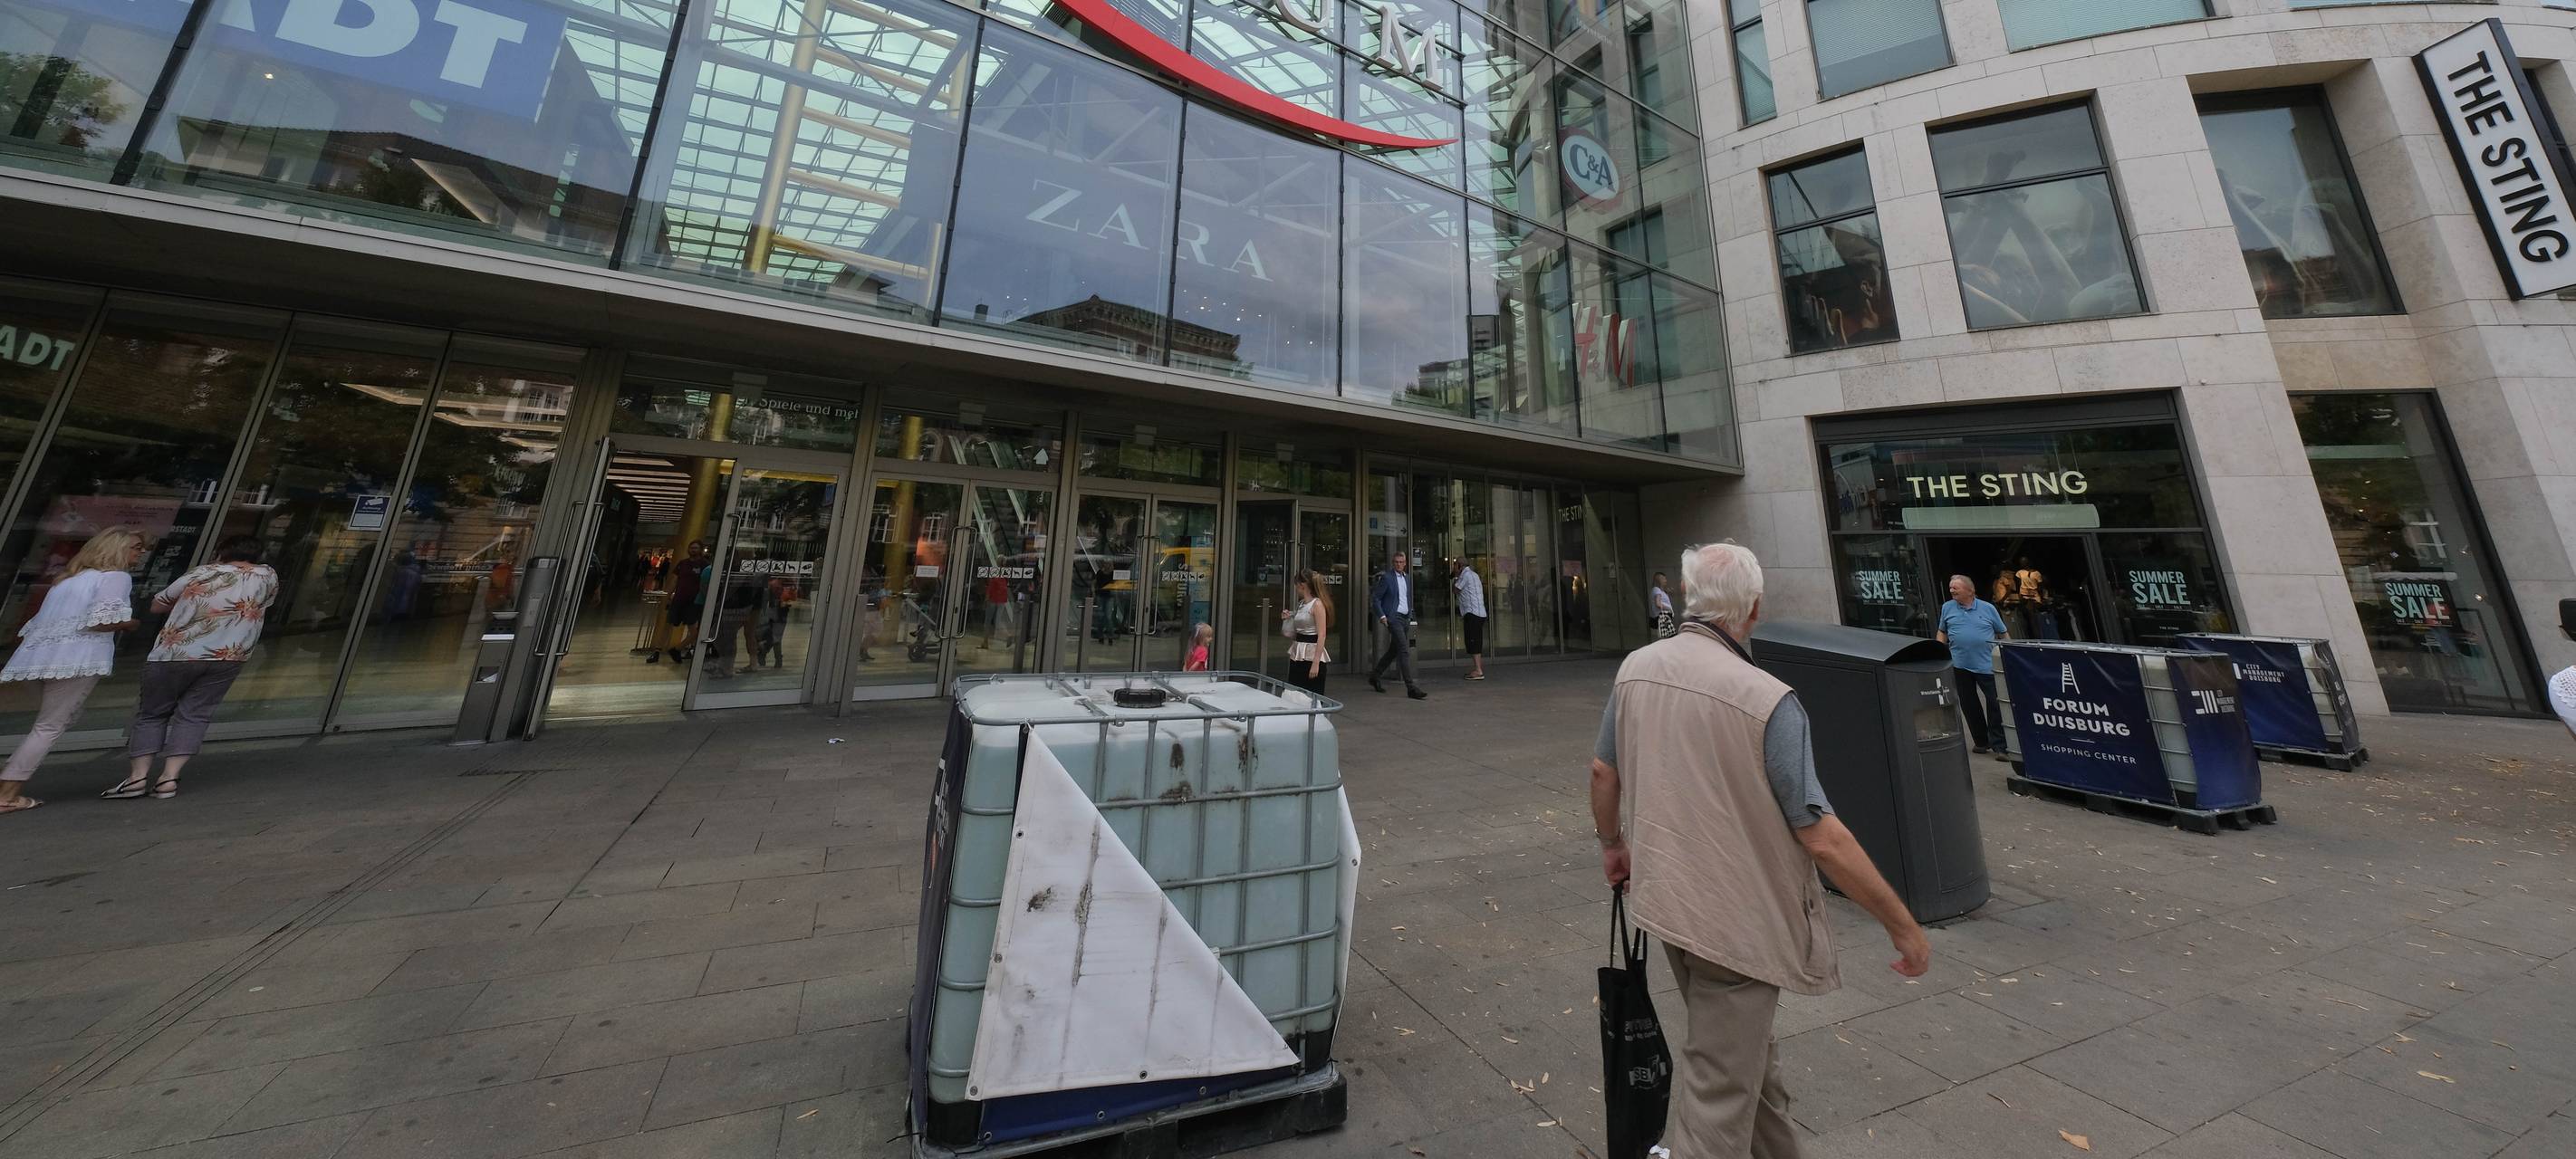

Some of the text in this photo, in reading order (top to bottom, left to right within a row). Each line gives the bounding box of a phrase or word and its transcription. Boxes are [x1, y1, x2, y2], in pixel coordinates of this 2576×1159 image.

[216, 0, 528, 89] DT
[1569, 144, 1614, 187] C&A
[2447, 50, 2569, 263] THE STING
[1025, 179, 1274, 282] ZARA
[805, 404, 831, 416] und
[1906, 470, 2088, 498] THE STING
[1858, 570, 1901, 581] SUMMER
[2129, 570, 2186, 584] SUMMER
[1860, 581, 1905, 599] SALE
[2132, 582, 2191, 605] SALE
[2385, 582, 2443, 598] SUMMER
[2389, 596, 2450, 619] SALE
[2043, 697, 2110, 717] FORUM
[2033, 712, 2131, 736] DUISBURG
[2041, 743, 2137, 764] SHOPPING CENTER
